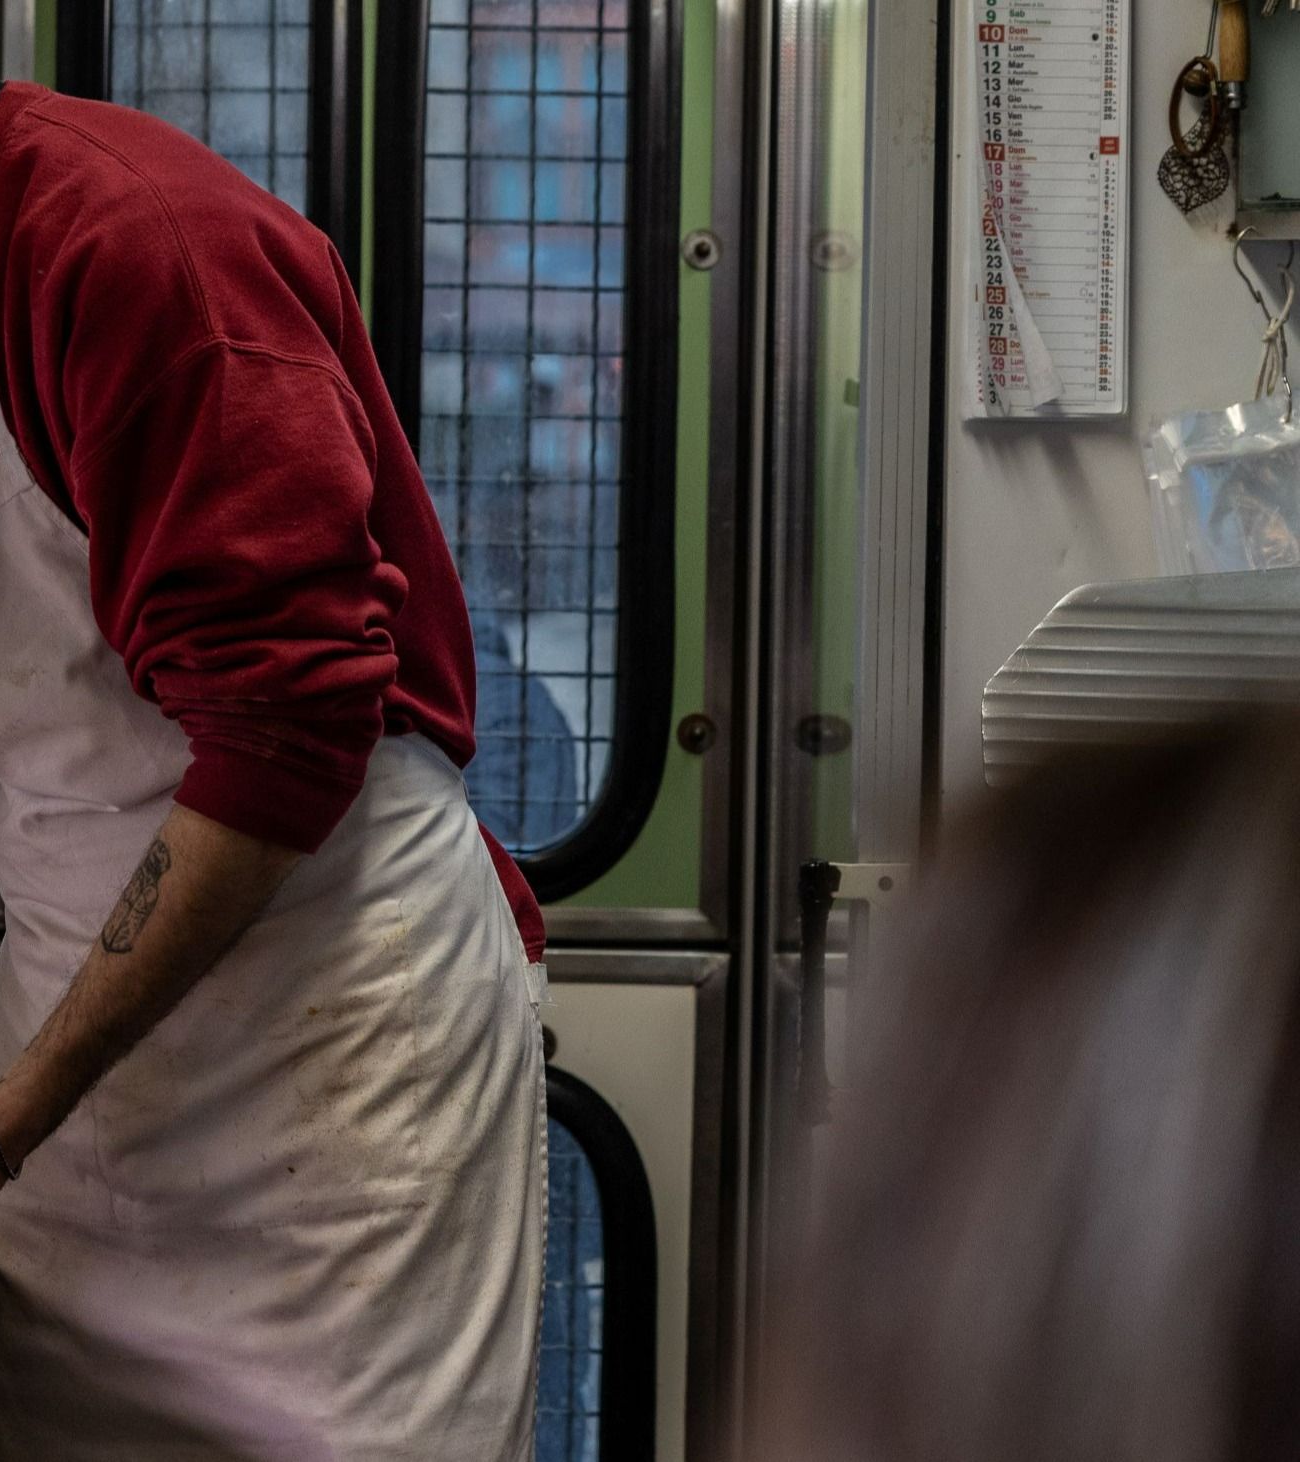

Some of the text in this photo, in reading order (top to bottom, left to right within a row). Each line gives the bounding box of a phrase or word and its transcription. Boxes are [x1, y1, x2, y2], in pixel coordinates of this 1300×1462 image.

[986, 9, 997, 23] 9
[981, 26, 1002, 40] 10
[1008, 26, 1028, 35] Dom
[982, 44, 999, 57] 11
[1008, 43, 1024, 52] Lun
[983, 61, 1001, 74] 12
[1008, 60, 1024, 68] Mar
[983, 78, 1001, 91] 13
[984, 95, 1001, 108] 14
[984, 112, 1001, 125] 15
[985, 129, 1002, 142] 16
[986, 145, 1002, 159] 17
[1008, 146, 1026, 154] Dom
[988, 162, 1003, 176] 18
[989, 180, 1003, 193] 19
[986, 255, 1002, 269] 23
[987, 272, 1003, 285] 24
[988, 289, 1004, 303] 25
[988, 306, 1004, 320] 26
[989, 323, 1004, 336] 27
[990, 340, 1020, 354] 28 Do
[992, 357, 1005, 370] 29
